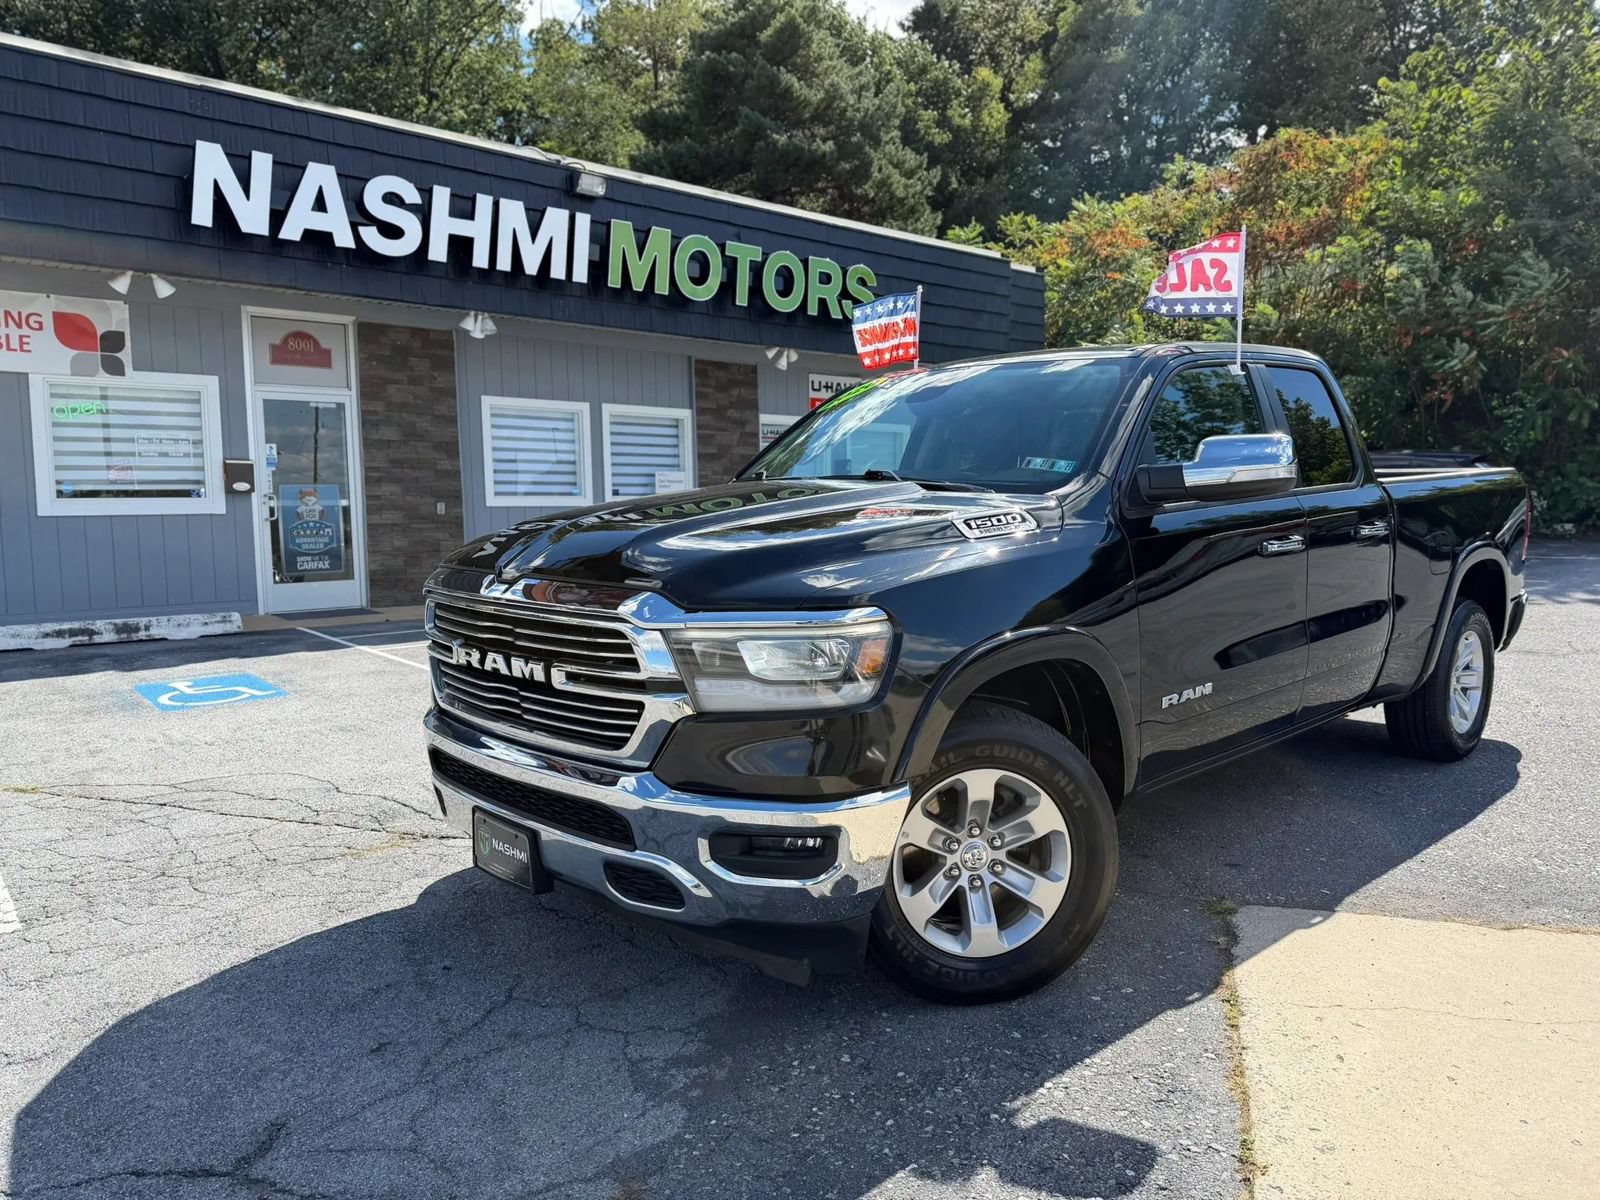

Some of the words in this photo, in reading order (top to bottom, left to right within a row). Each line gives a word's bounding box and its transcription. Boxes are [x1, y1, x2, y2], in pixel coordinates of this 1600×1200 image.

[190, 140, 591, 284] NASHMI
[607, 218, 877, 320] MOTORS
[0, 309, 44, 332] NG
[0, 333, 32, 353] LE
[287, 336, 314, 352] 8001
[811, 379, 854, 393] U-HA
[53, 401, 106, 419] open
[762, 428, 785, 436] U-HA
[966, 513, 1022, 530] 1500
[297, 561, 330, 570] CARFAX
[458, 646, 546, 682] RAM
[1161, 682, 1213, 709] RAM
[974, 743, 1049, 769] GUIDE
[492, 838, 528, 863] NASHMI
